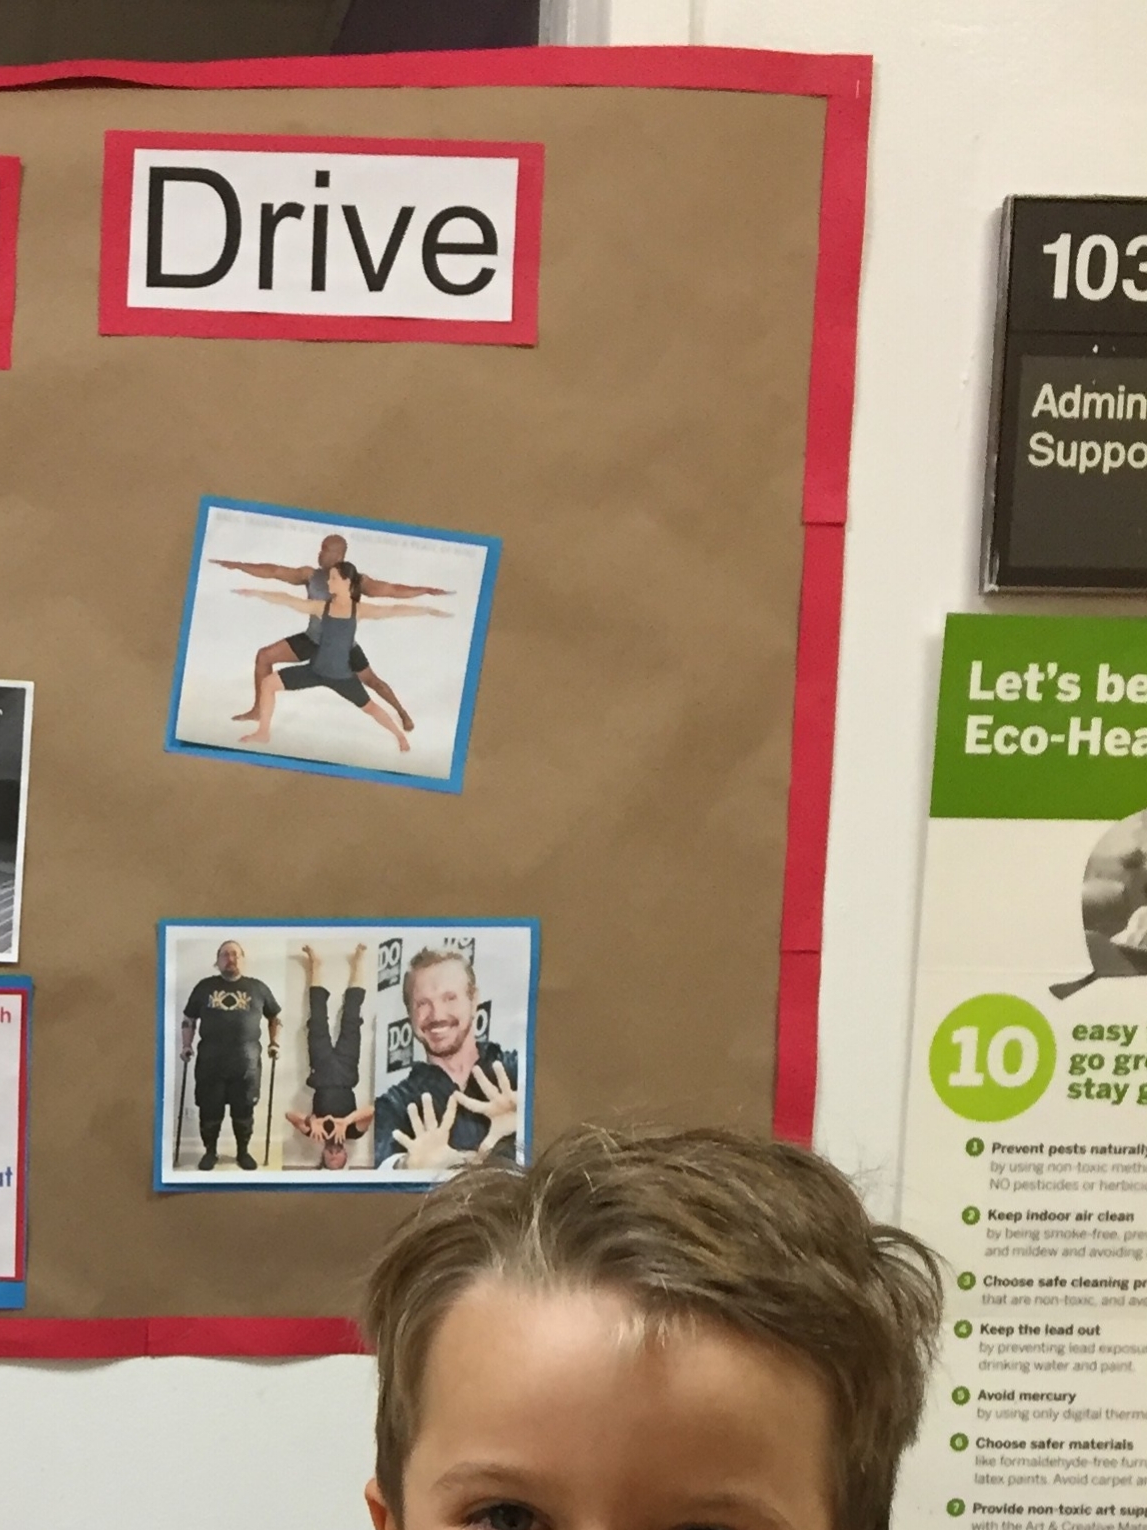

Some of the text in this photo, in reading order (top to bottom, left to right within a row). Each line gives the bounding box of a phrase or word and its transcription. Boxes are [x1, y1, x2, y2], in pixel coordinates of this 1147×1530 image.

[146, 167, 497, 296] Drive
[1043, 233, 1147, 302] 103
[1031, 383, 1147, 420] Admin
[1028, 431, 1147, 474] Suppo
[969, 660, 1147, 703] Let's be
[1072, 1024, 1138, 1047] easy
[948, 1025, 1039, 1088] 10
[1068, 1053, 1105, 1075] go
[1067, 1078, 1129, 1105] stay
[992, 1142, 1086, 1157] Prevent pests
[988, 1209, 1134, 1222] Keep indoor air clean
[983, 1275, 1129, 1291] Choose safe cleaning
[980, 1324, 1101, 1337] Keep the lead out
[978, 1389, 1076, 1404] Avoid mercury
[976, 1437, 1133, 1450] Choose safer materials
[973, 1502, 1115, 1515] Provide non-toxic art
